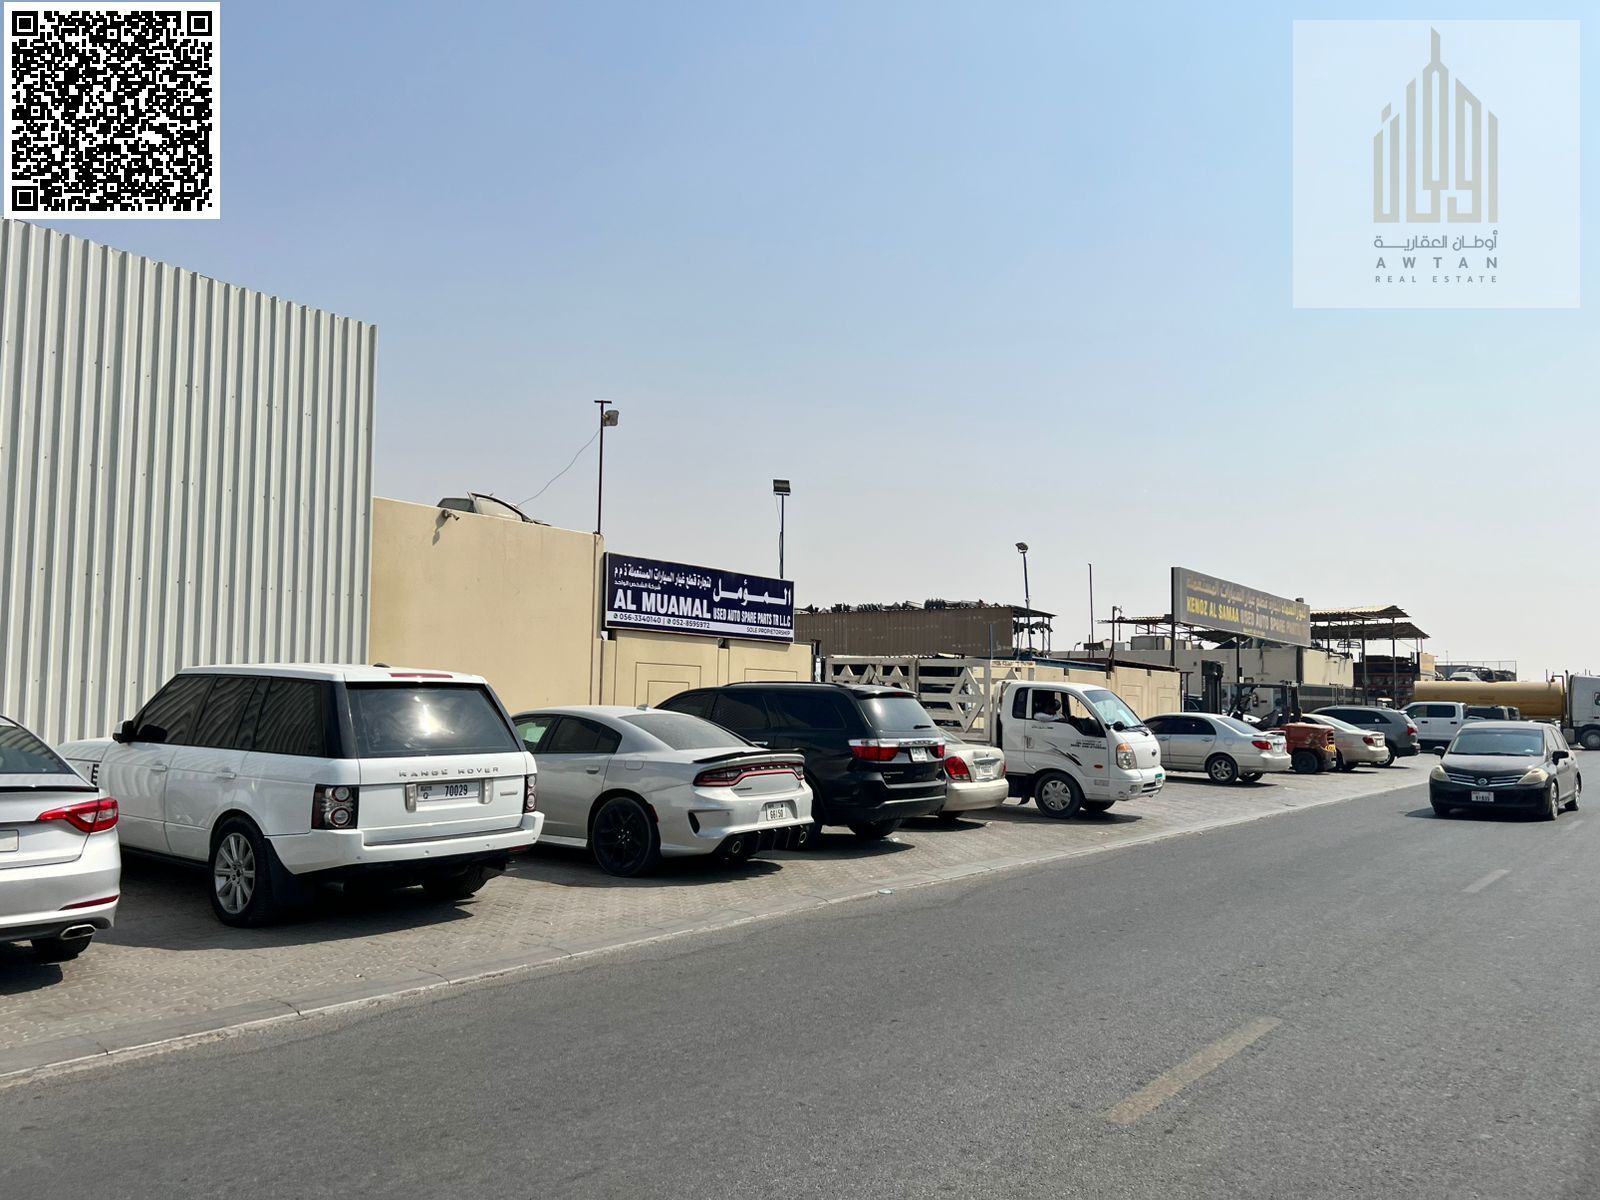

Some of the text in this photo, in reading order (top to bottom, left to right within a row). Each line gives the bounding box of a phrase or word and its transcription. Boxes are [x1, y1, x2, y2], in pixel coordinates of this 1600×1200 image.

[613, 588, 711, 619] AL MUAMAL
[1208, 603, 1218, 618] AL
[712, 607, 727, 620] USED
[727, 609, 741, 623] AUTO
[741, 610, 757, 624] SPARE
[757, 612, 772, 626] PARTS
[772, 614, 779, 626] TR
[746, 626, 758, 634] SOLE
[398, 766, 499, 778] RANGE ROVER
[444, 784, 468, 797] 70029
